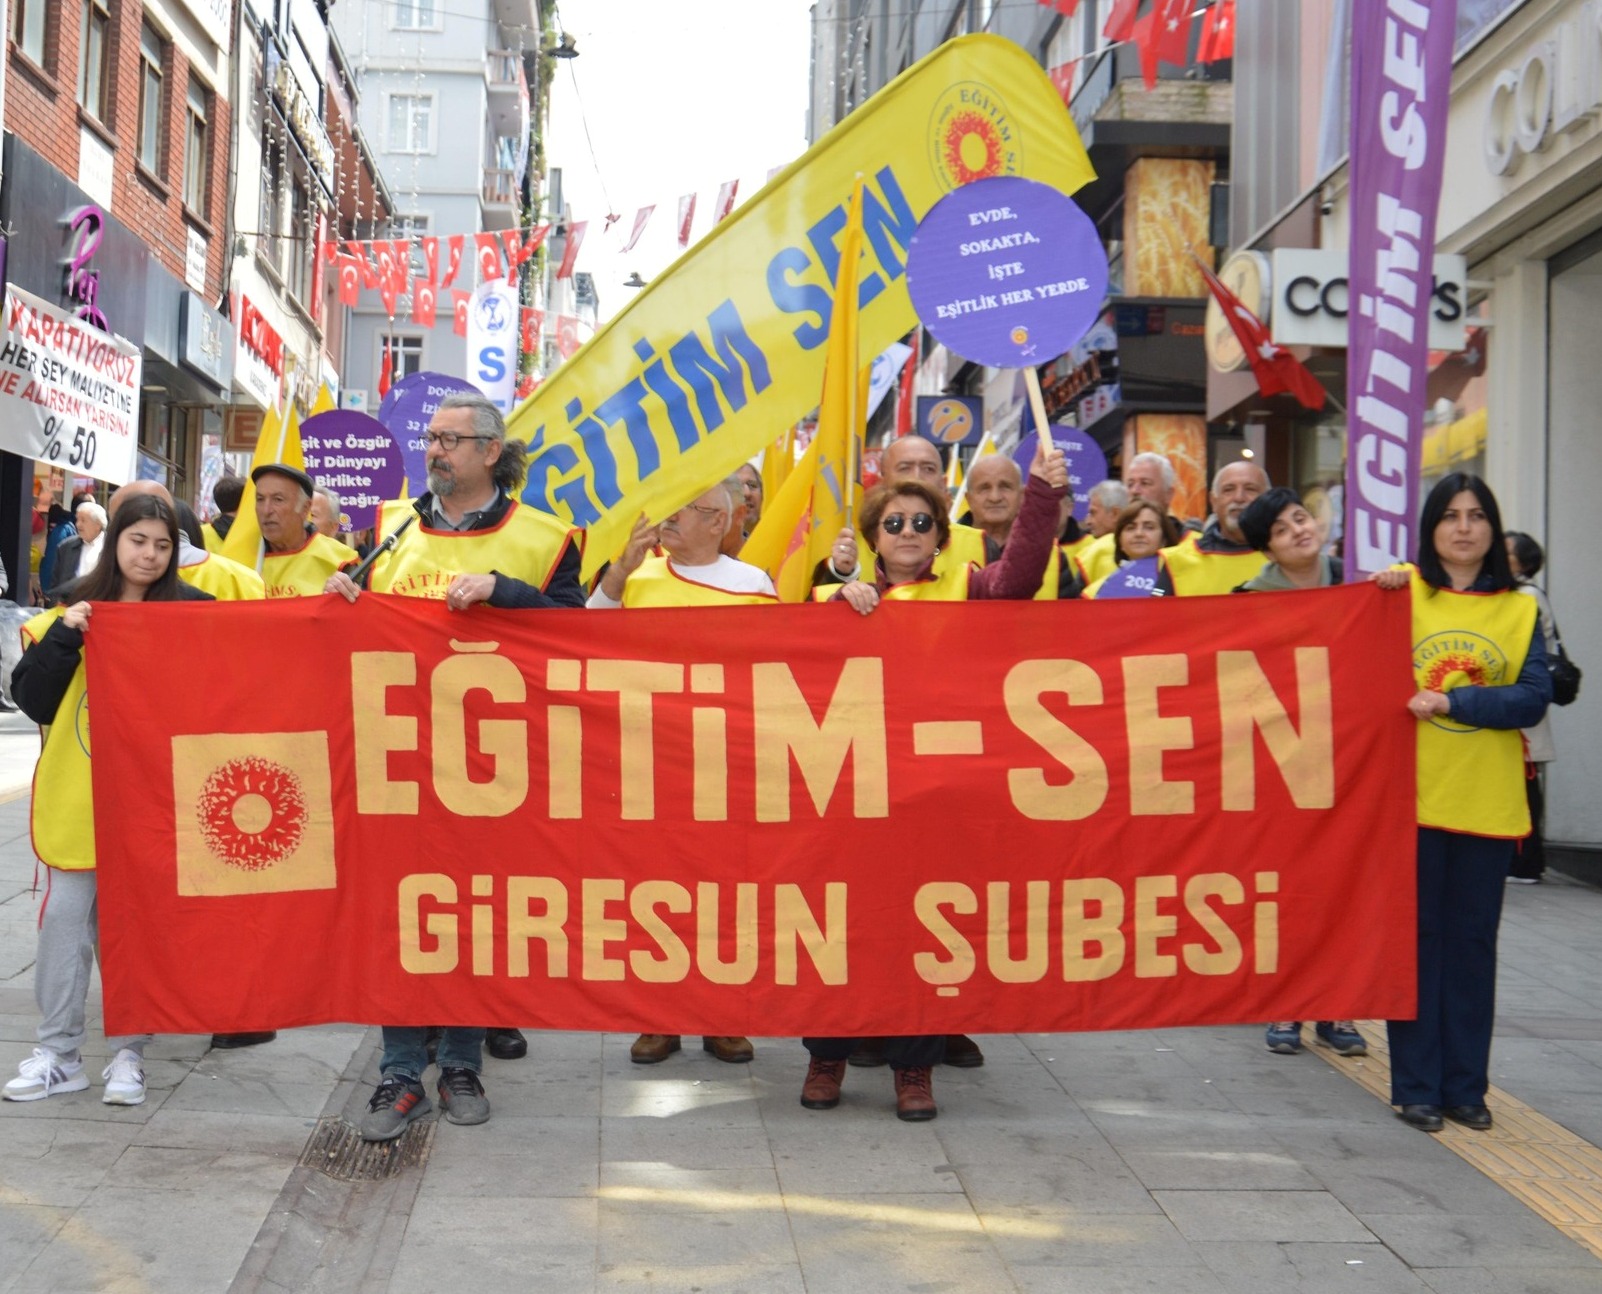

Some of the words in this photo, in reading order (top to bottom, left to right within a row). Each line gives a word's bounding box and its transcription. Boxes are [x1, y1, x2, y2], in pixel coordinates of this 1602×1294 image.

[968, 206, 1018, 226] EVDE,
[959, 231, 1041, 257] SOKAKTA,
[988, 261, 1026, 281] İŞTE
[936, 293, 998, 319] EŞİTLİK
[1001, 287, 1035, 306] HER
[1034, 277, 1090, 299] YERDE
[8, 296, 136, 389] KAPATIYORUZ
[519, 298, 774, 530] ĞİTİM
[765, 165, 920, 351] SEN
[0, 341, 37, 376] HER
[406, 420, 421, 431] 32
[69, 426, 97, 470] 50
[301, 435, 321, 452] şit
[322, 438, 343, 449] ve
[345, 433, 392, 451] Özgür
[323, 454, 387, 470] Dünyayı
[314, 473, 372, 487] Birlikte
[339, 493, 380, 509] cağız
[1124, 575, 1155, 590] 202
